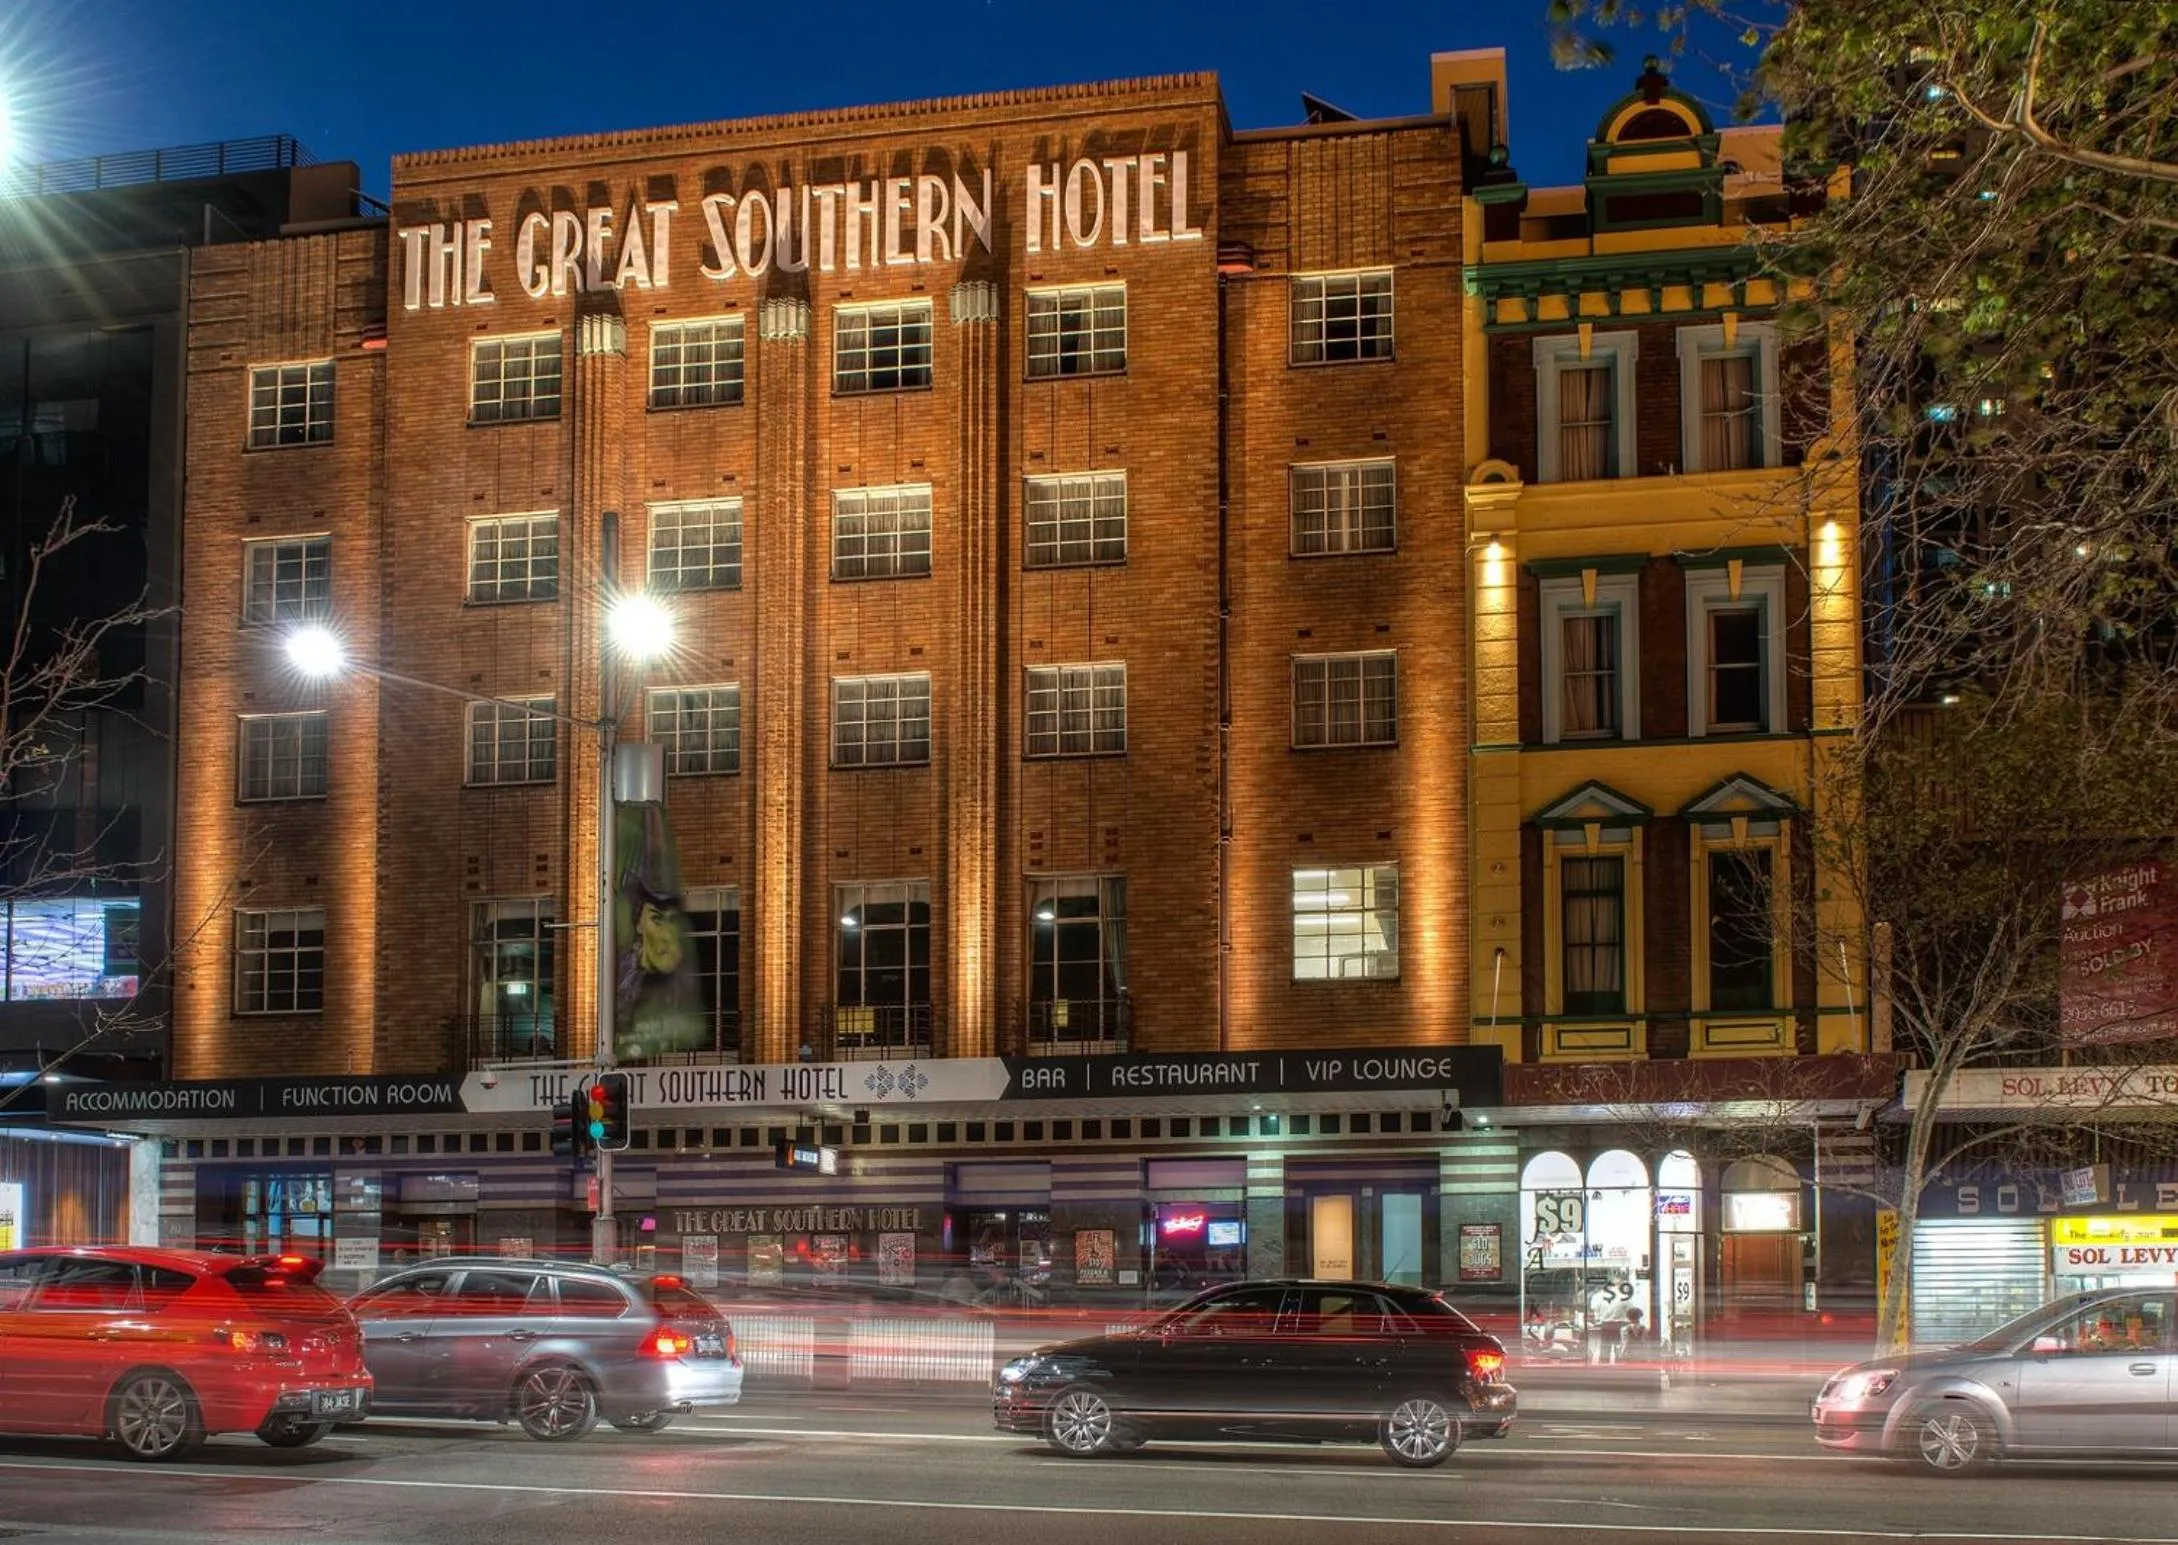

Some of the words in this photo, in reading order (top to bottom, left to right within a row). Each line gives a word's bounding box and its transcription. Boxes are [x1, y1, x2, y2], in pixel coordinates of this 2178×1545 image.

[398, 218, 495, 310] THE
[516, 200, 679, 299] GREAT
[700, 167, 992, 280] SOUTHERN
[1026, 150, 1203, 253] HOTEL
[2100, 891, 2150, 913] Frank
[529, 1074, 569, 1106] THE
[659, 1068, 766, 1103] SOUTHERN
[780, 1067, 849, 1100] HOTEL
[1021, 1067, 1066, 1089] BAR
[1111, 1062, 1261, 1087] RESTAURANT
[1306, 1060, 1343, 1081] VIP
[1353, 1057, 1452, 1080] LOUNGE
[66, 1088, 236, 1112] ACCOMMODATION
[282, 1084, 379, 1107] FUNCTION
[386, 1083, 453, 1105] ROOM
[2002, 1077, 2047, 1098] SOL
[2059, 1076, 2121, 1096] LEVY
[674, 1210, 708, 1233] THE
[711, 1209, 768, 1233] GREAT
[772, 1207, 864, 1232] SOUTHERN
[868, 1208, 924, 1231] HOTEL
[1536, 1195, 1583, 1234] $9
[2068, 1248, 2112, 1265] SOL
[2120, 1248, 2178, 1264] LEVY
[1602, 1282, 1635, 1304] $9
